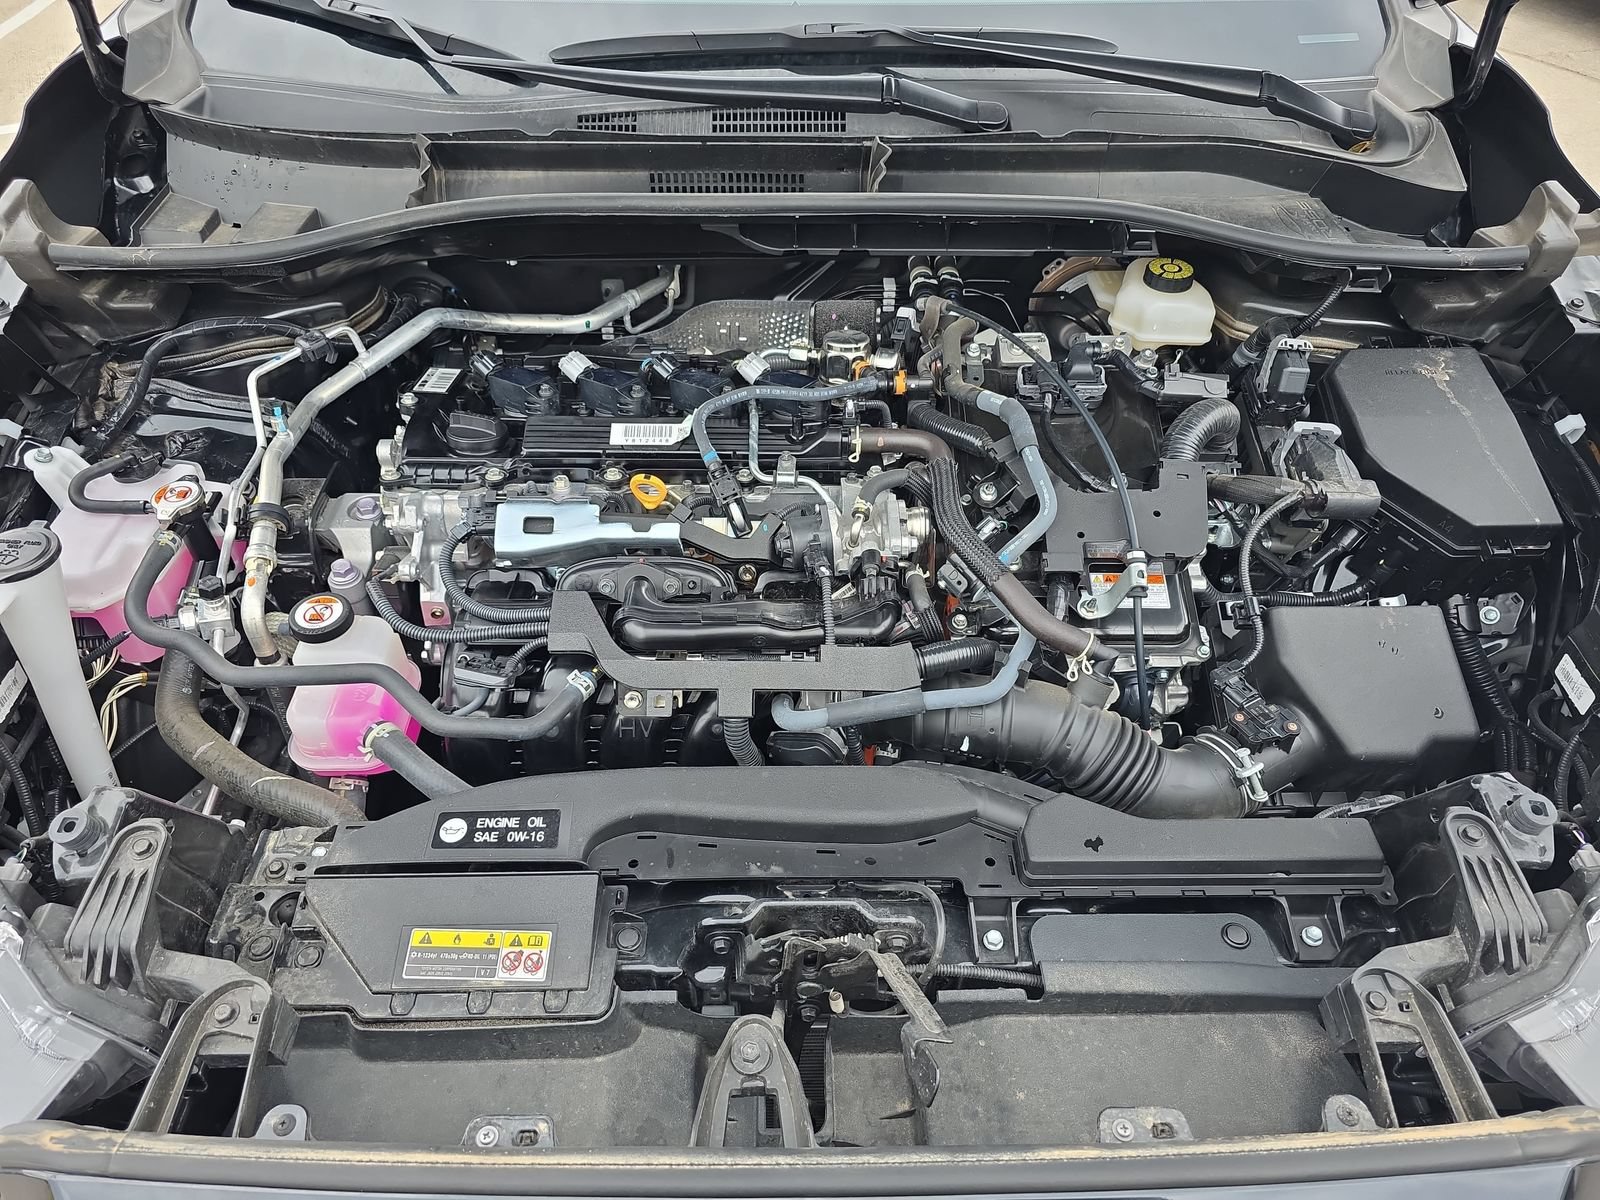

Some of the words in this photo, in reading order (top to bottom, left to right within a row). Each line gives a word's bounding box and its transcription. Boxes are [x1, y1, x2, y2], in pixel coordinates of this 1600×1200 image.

[618, 718, 654, 738] HV
[476, 817, 520, 829] ENGINE
[527, 816, 547, 828] OIL
[473, 831, 499, 843] SAE
[506, 831, 545, 842] 0W-16
